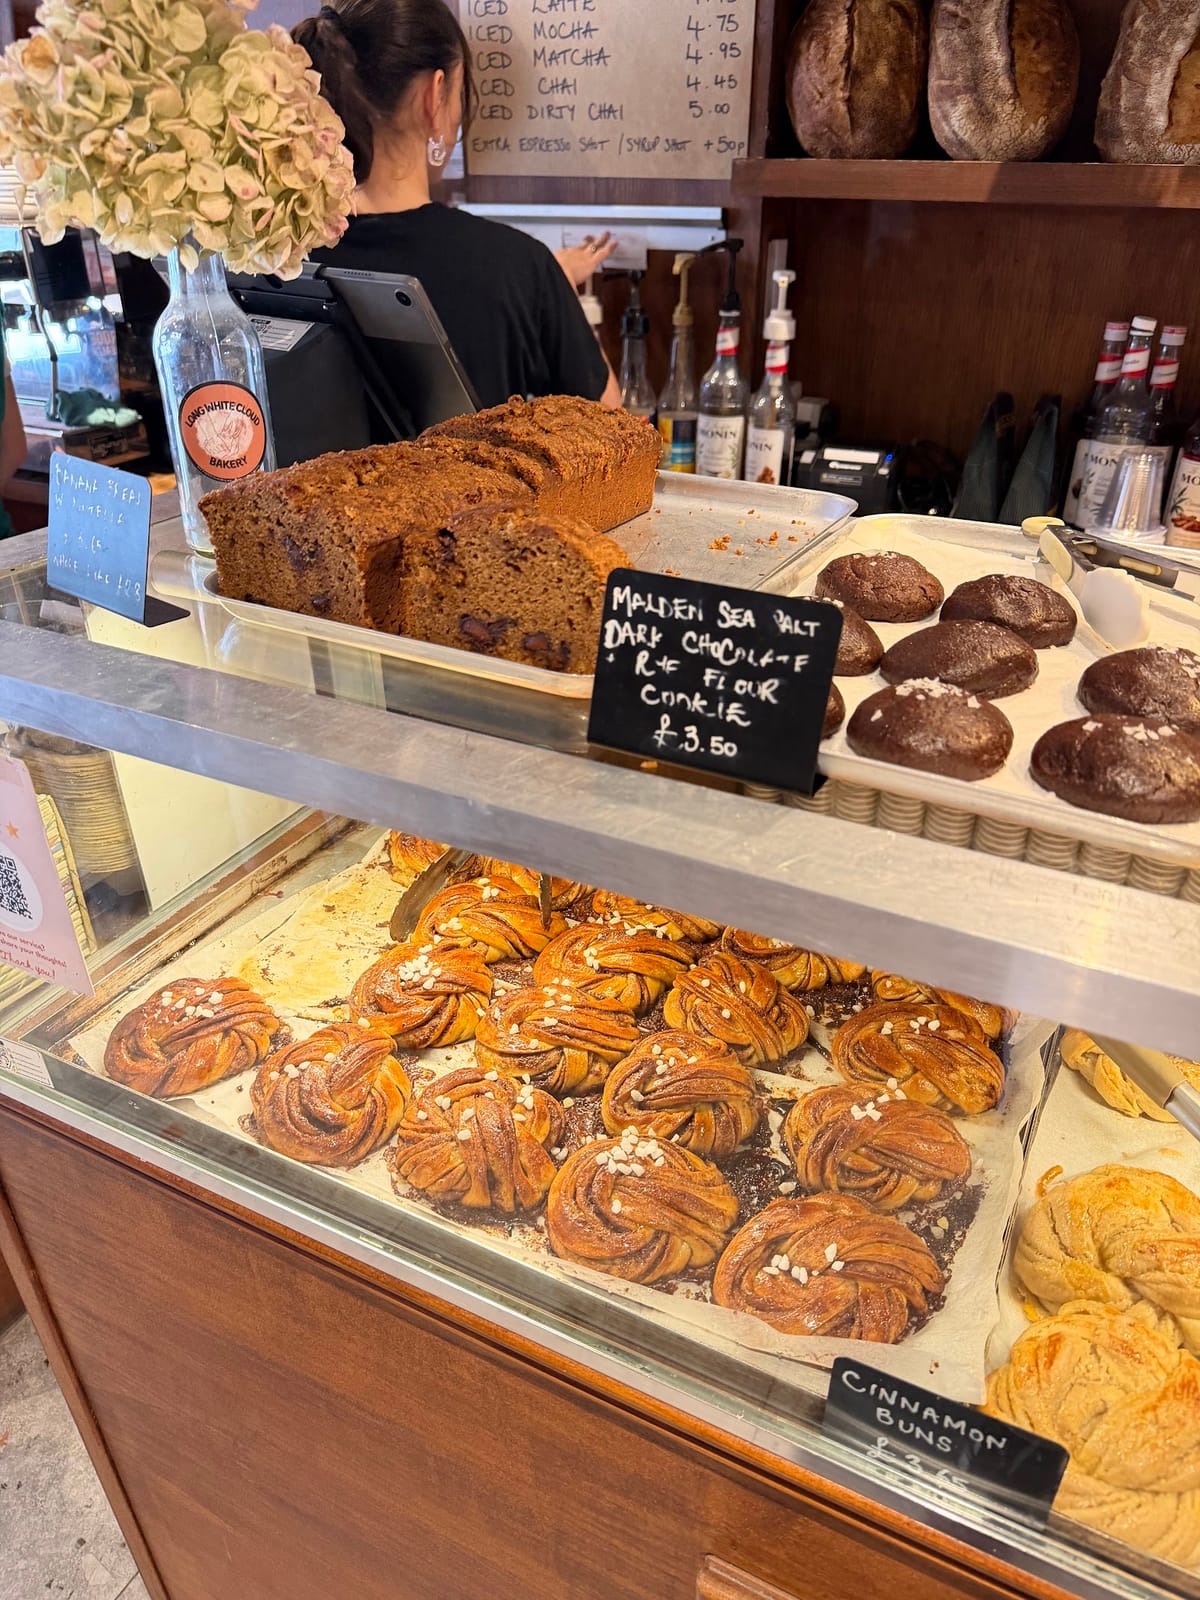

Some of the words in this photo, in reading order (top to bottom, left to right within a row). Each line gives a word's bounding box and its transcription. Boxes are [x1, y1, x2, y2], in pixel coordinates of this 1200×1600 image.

[468, 0, 508, 17] ICED
[469, 25, 513, 44] ICED
[533, 21, 599, 40] MOCHA
[686, 14, 739, 40] 4.75
[476, 51, 512, 71] CED
[533, 46, 611, 69] MATCHA
[686, 42, 742, 64] 4.95
[479, 78, 515, 97] CED
[538, 77, 577, 95] CHAI
[686, 74, 738, 92] 4.45
[479, 105, 513, 121] CED
[527, 104, 575, 121] DIRTY
[588, 102, 624, 121] CHAI
[688, 100, 731, 119] 5.00
[472, 138, 511, 152] EXTRA
[185, 406, 206, 428] LONG
[203, 401, 235, 413] WHITE
[235, 403, 260, 427] CLOUD
[209, 455, 248, 469] BAKERY
[612, 585, 703, 621] MALDEN
[717, 600, 756, 629] SEA
[773, 609, 821, 637] SALT
[604, 619, 663, 649] DARK
[682, 631, 810, 673] CHOCOLATE
[703, 668, 779, 704] FLOUR
[842, 1370, 1007, 1450] CINNAMON
[877, 1407, 952, 1452] BUNS
